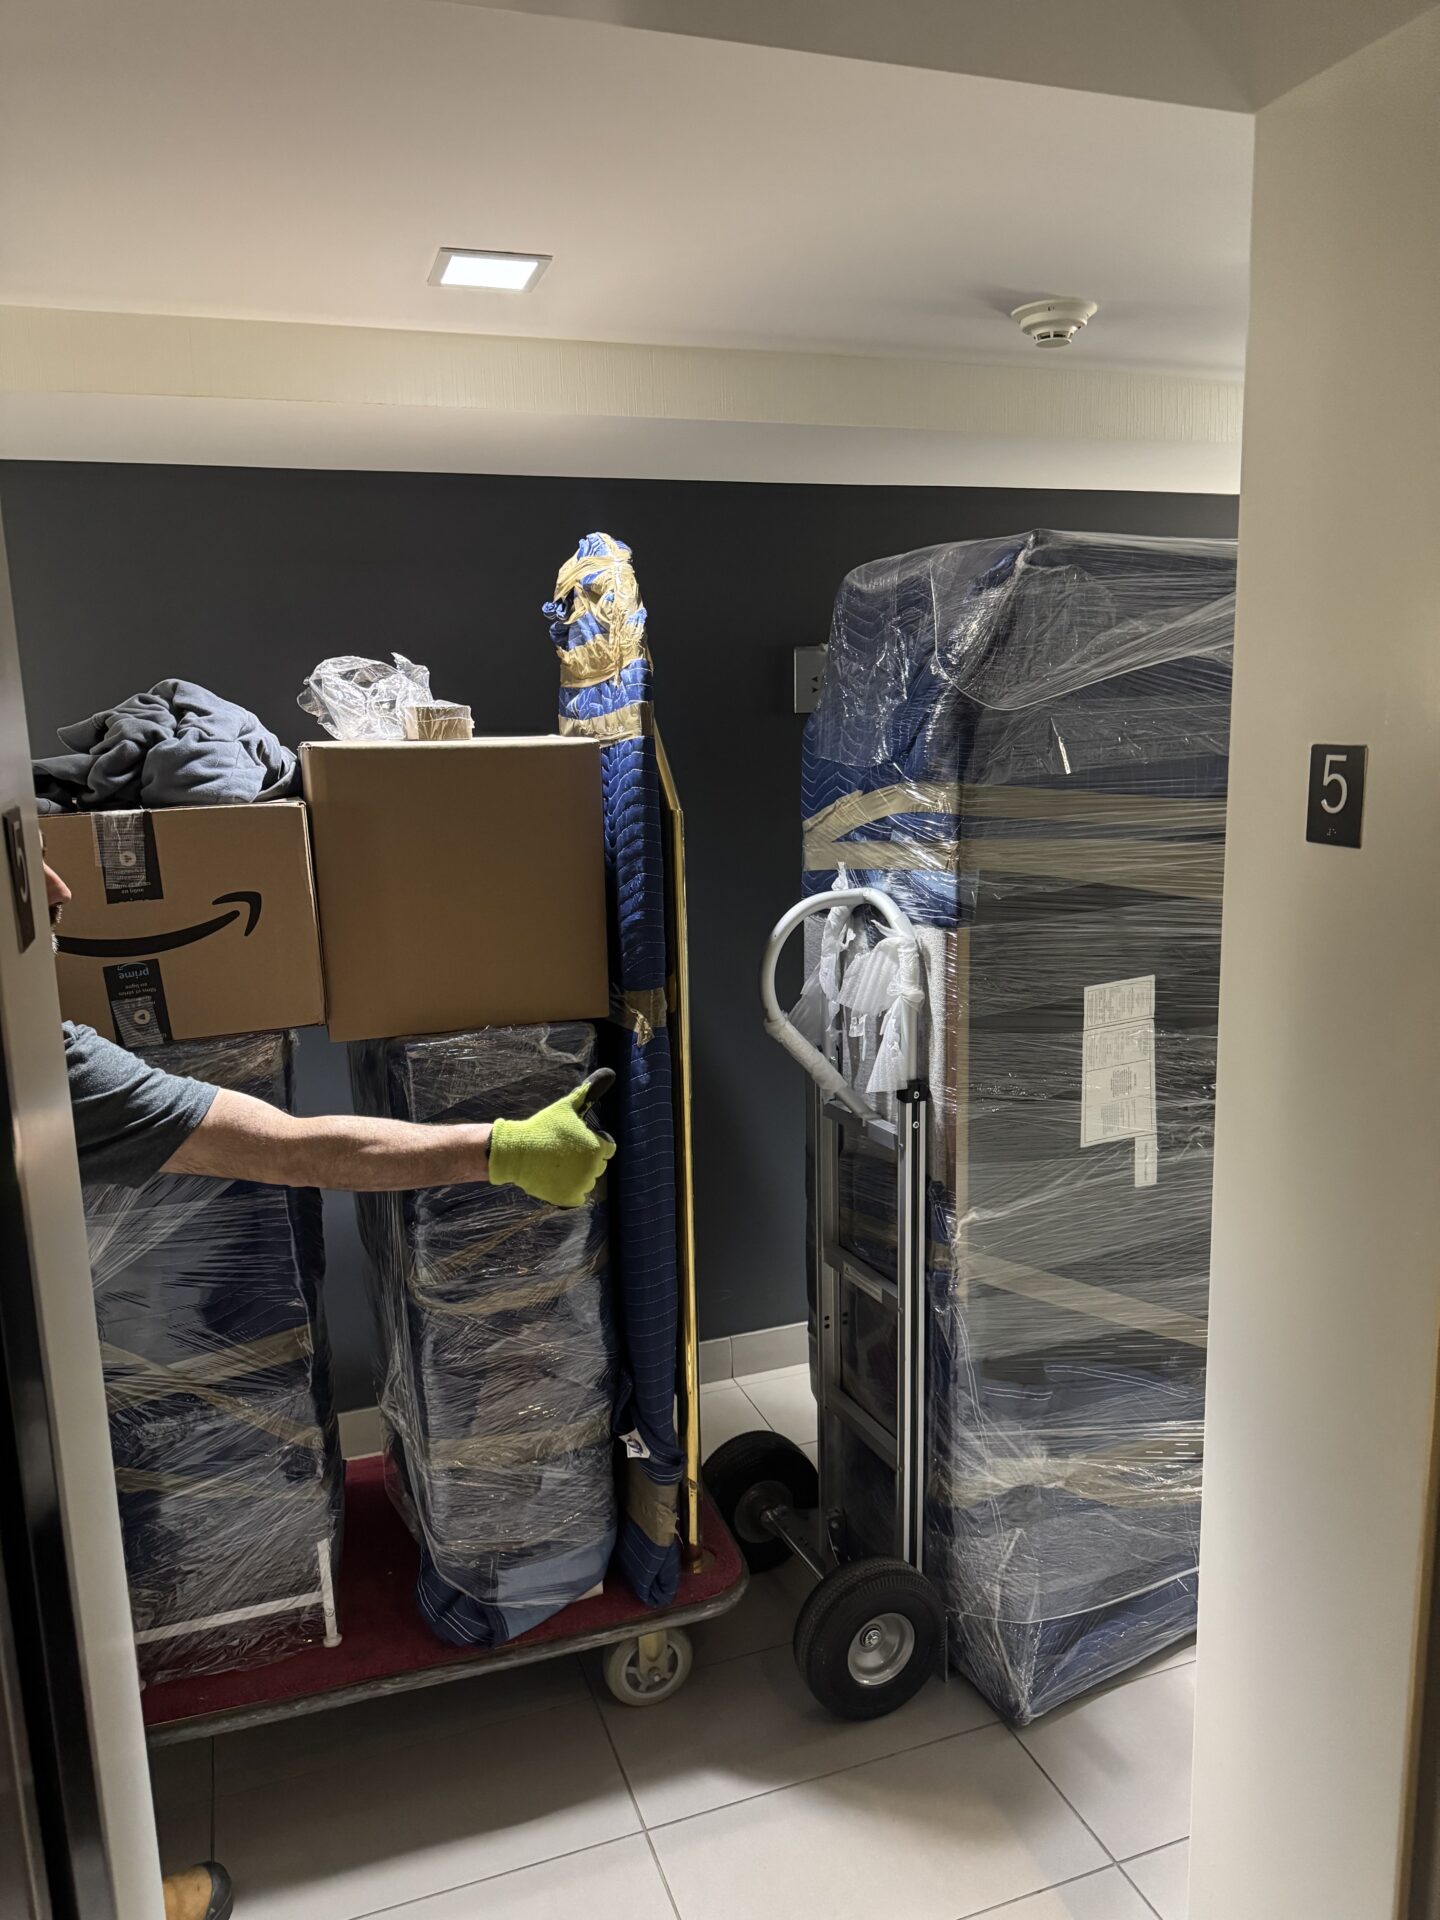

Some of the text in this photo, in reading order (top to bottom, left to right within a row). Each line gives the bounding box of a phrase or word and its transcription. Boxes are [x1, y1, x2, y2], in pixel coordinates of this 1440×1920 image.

[1321, 754, 1348, 814] 5
[13, 820, 28, 903] 5
[118, 967, 149, 979] prime
